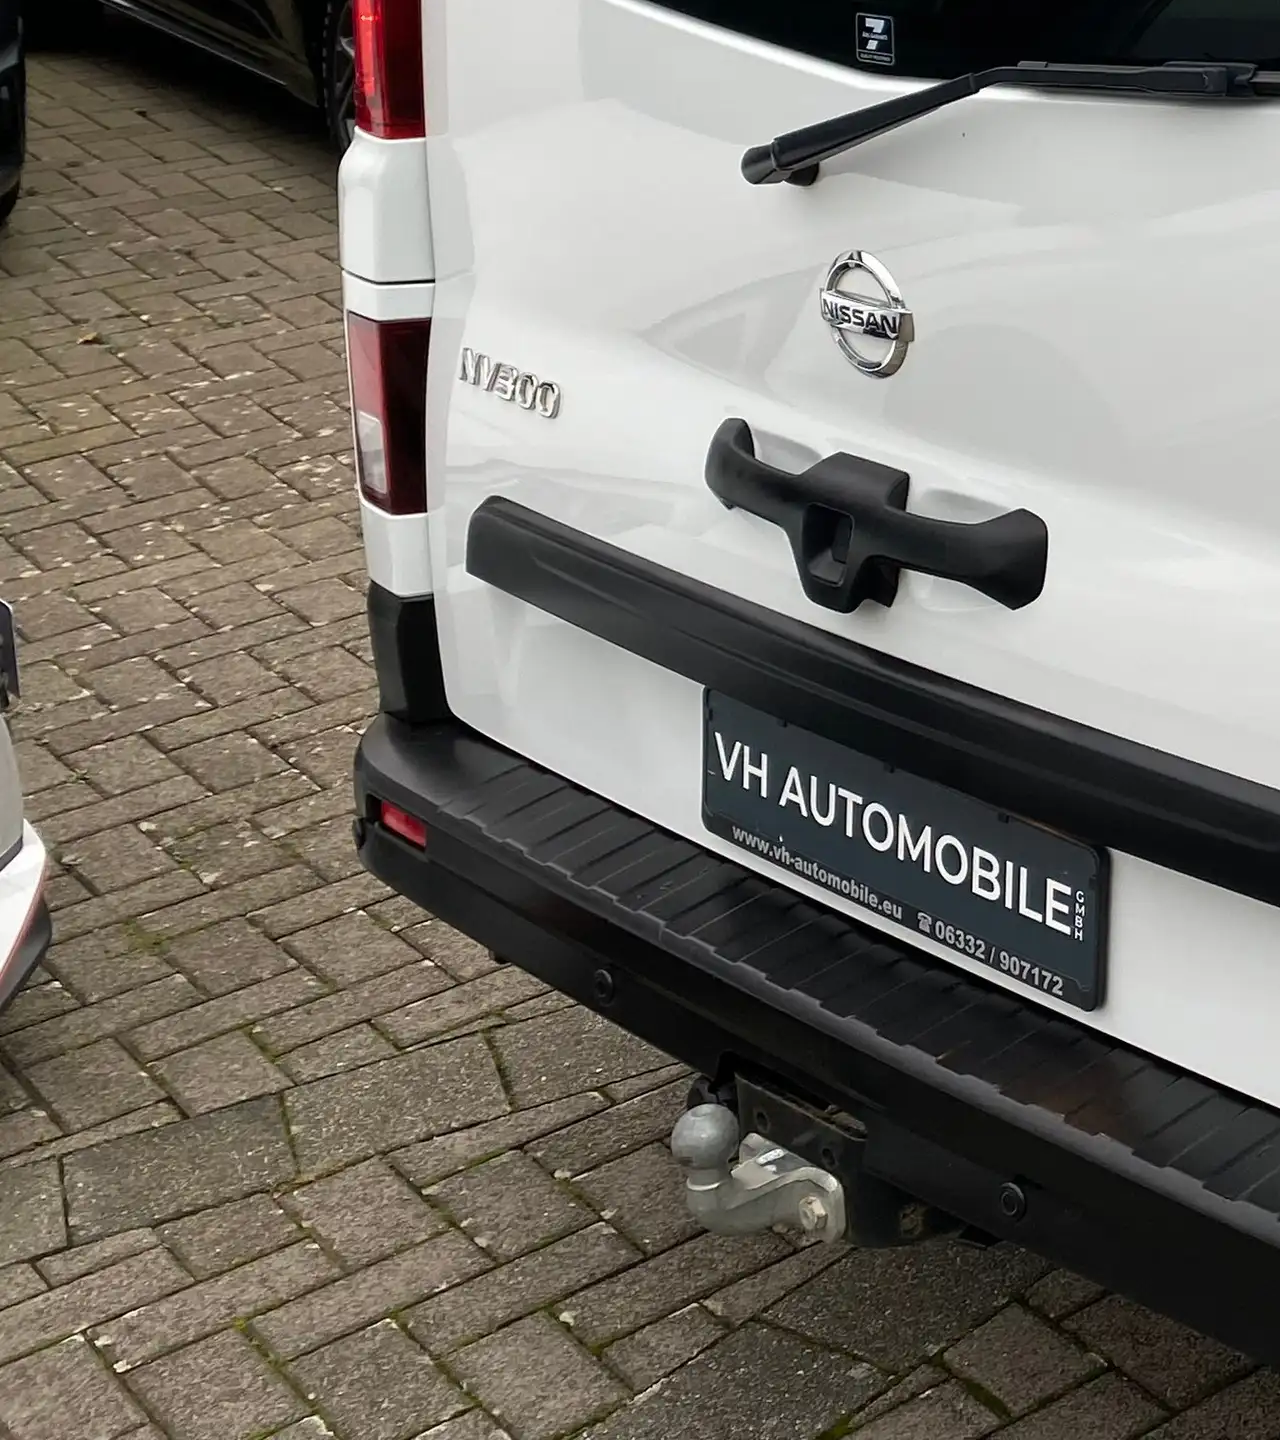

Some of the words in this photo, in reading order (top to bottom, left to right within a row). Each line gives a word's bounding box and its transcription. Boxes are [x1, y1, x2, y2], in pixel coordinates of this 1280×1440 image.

[822, 298, 898, 335] NISSAN
[460, 347, 561, 420] NV300
[714, 731, 768, 799] VH
[778, 766, 1072, 936] AUTOMOBILE
[1074, 890, 1085, 942] GMBH
[732, 824, 903, 920] www.vh-automobile.eu
[934, 920, 986, 959] 06332
[1000, 951, 1064, 997] 907172
